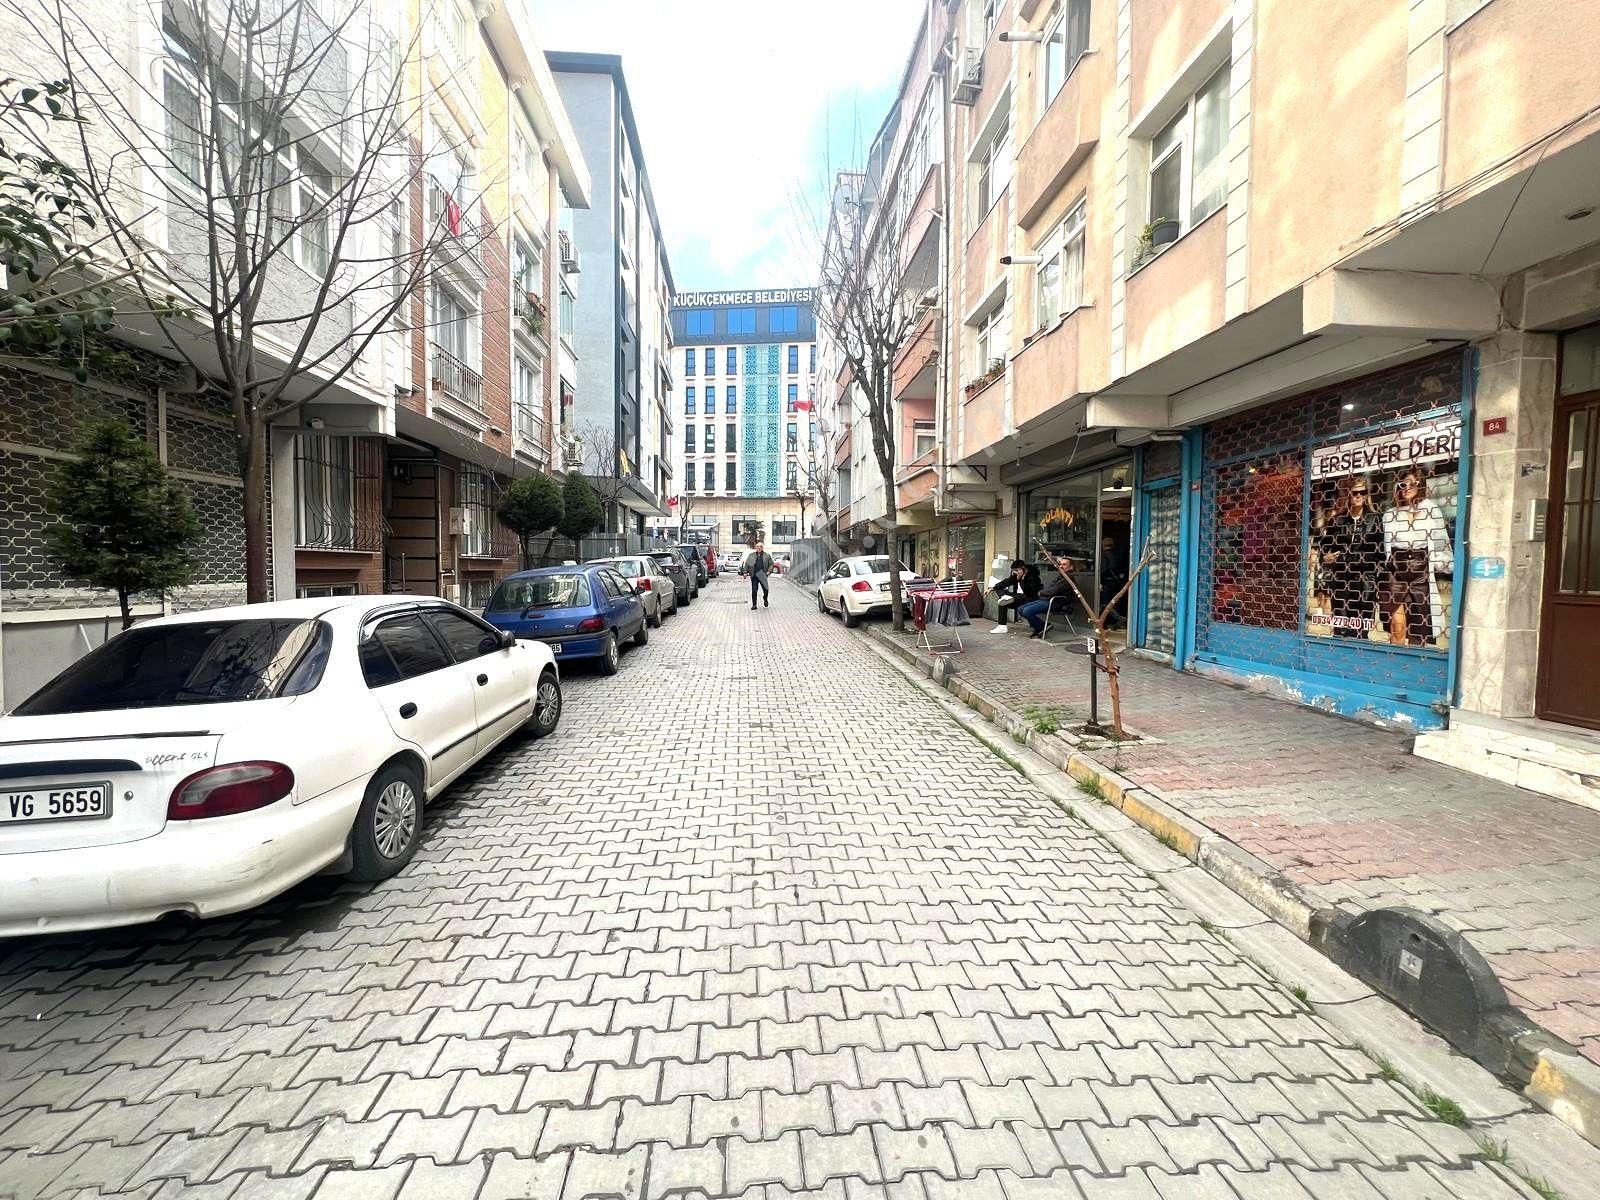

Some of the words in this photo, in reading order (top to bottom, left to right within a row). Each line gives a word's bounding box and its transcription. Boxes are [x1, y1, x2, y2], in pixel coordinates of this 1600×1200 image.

[673, 290, 753, 307] KÜÇÜKÇEKMECE
[1488, 421, 1501, 431] 84
[1319, 443, 1401, 473] ERSEVER
[9, 794, 34, 818] VG
[49, 790, 102, 815] 5659
